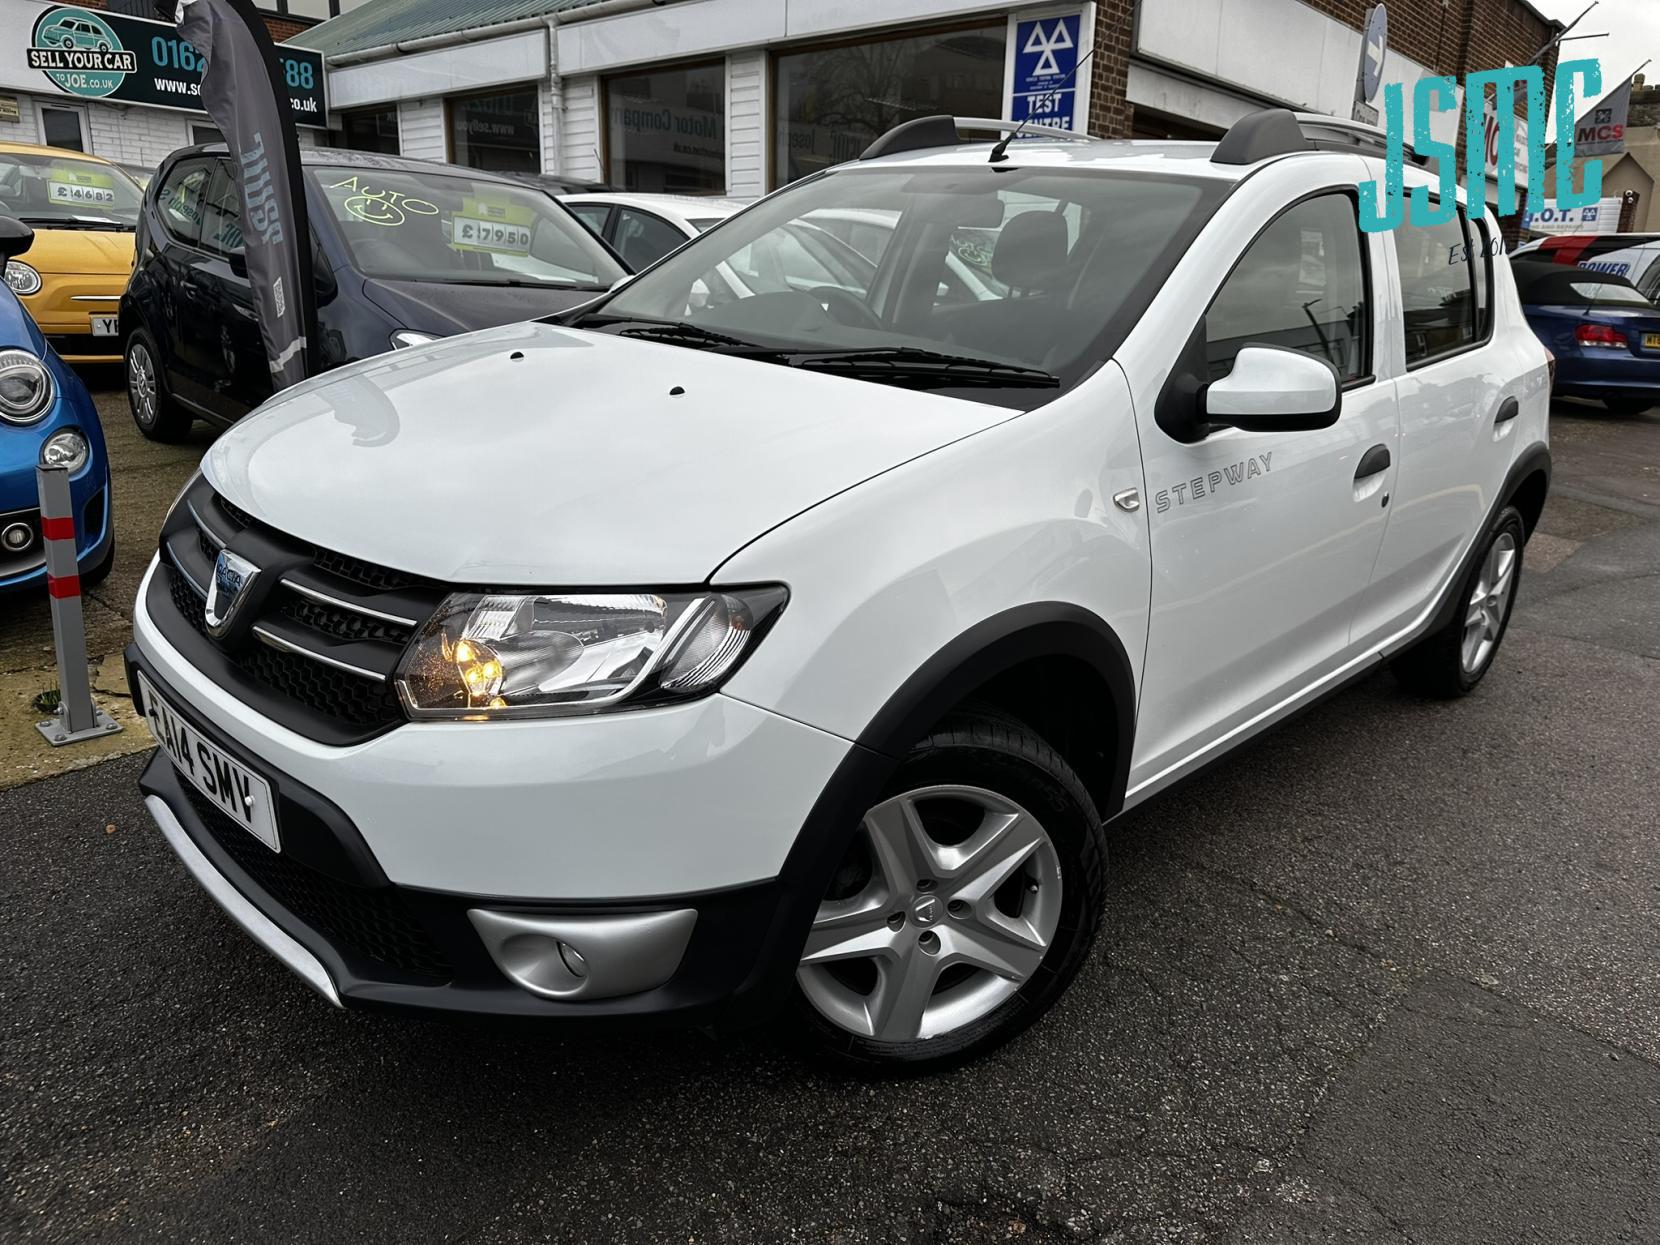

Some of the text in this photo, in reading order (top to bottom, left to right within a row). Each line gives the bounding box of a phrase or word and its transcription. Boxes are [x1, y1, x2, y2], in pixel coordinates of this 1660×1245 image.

[31, 51, 132, 70] SELL YOUR CAR
[1027, 93, 1062, 114] TEST
[1578, 124, 1624, 142] MCS
[329, 176, 439, 215] AUTO
[1155, 451, 1272, 514] STEPWAY
